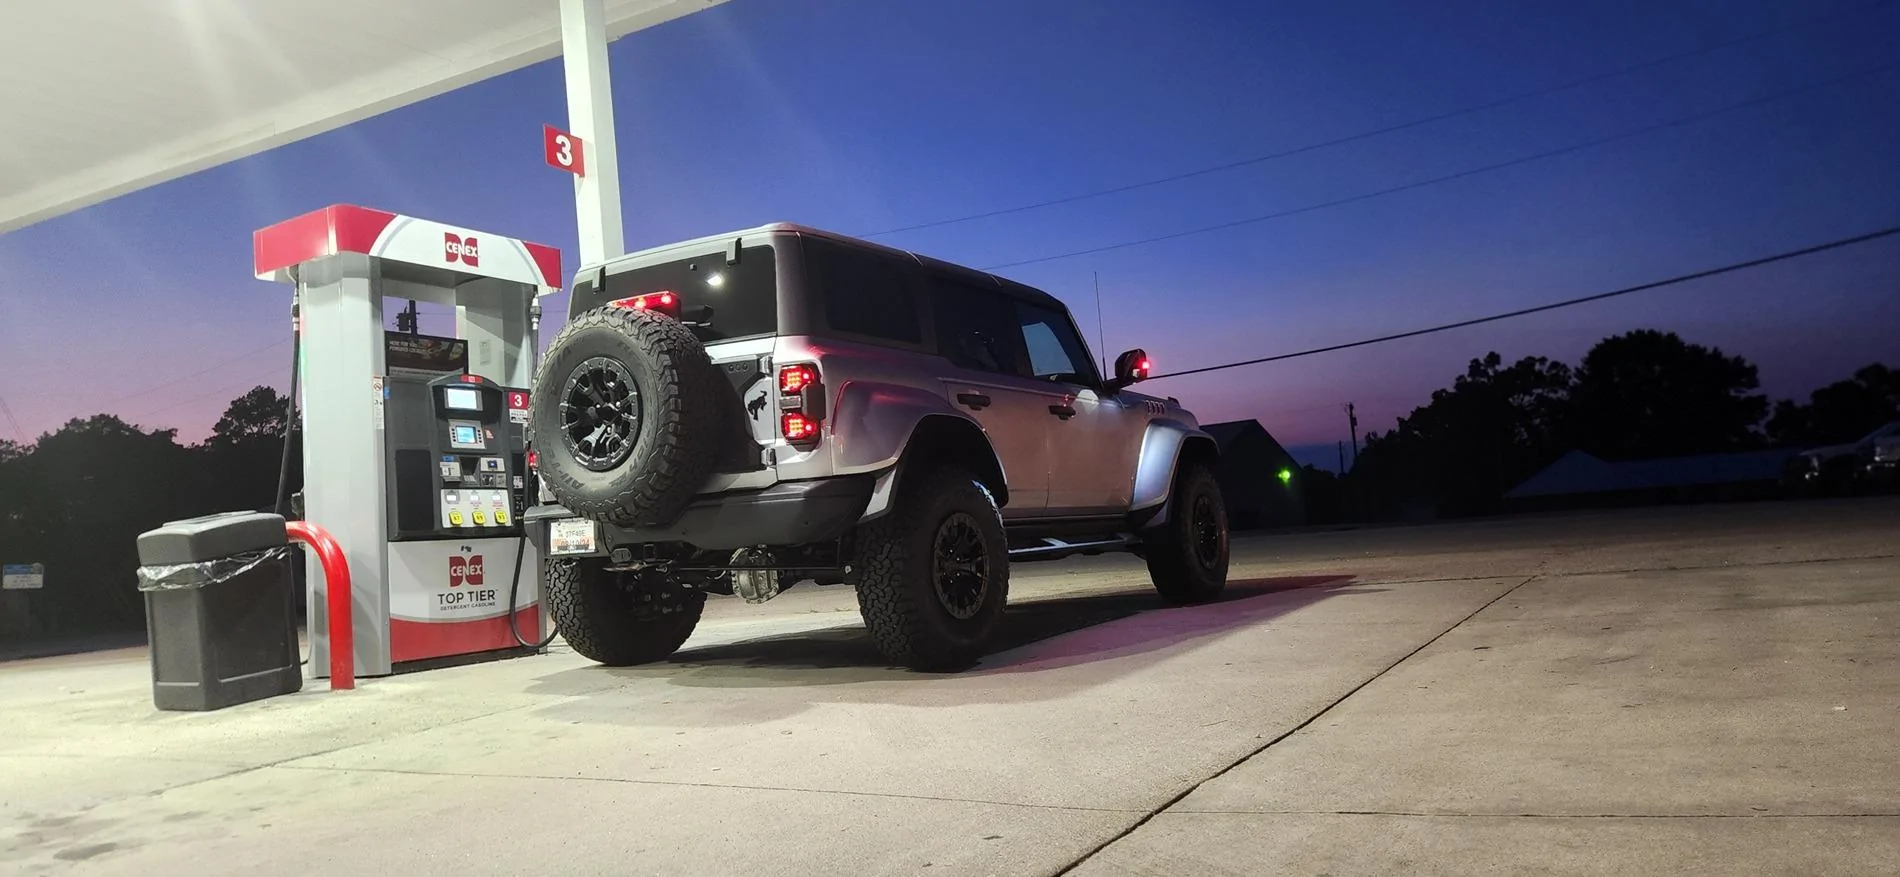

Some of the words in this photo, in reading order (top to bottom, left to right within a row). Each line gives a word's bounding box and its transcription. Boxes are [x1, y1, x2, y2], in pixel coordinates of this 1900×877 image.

[555, 134, 573, 167] 3
[446, 241, 478, 258] CENEX
[514, 394, 523, 407] 3
[450, 564, 482, 577] CENEX
[437, 592, 464, 605] TOP
[467, 589, 496, 602] TIER
